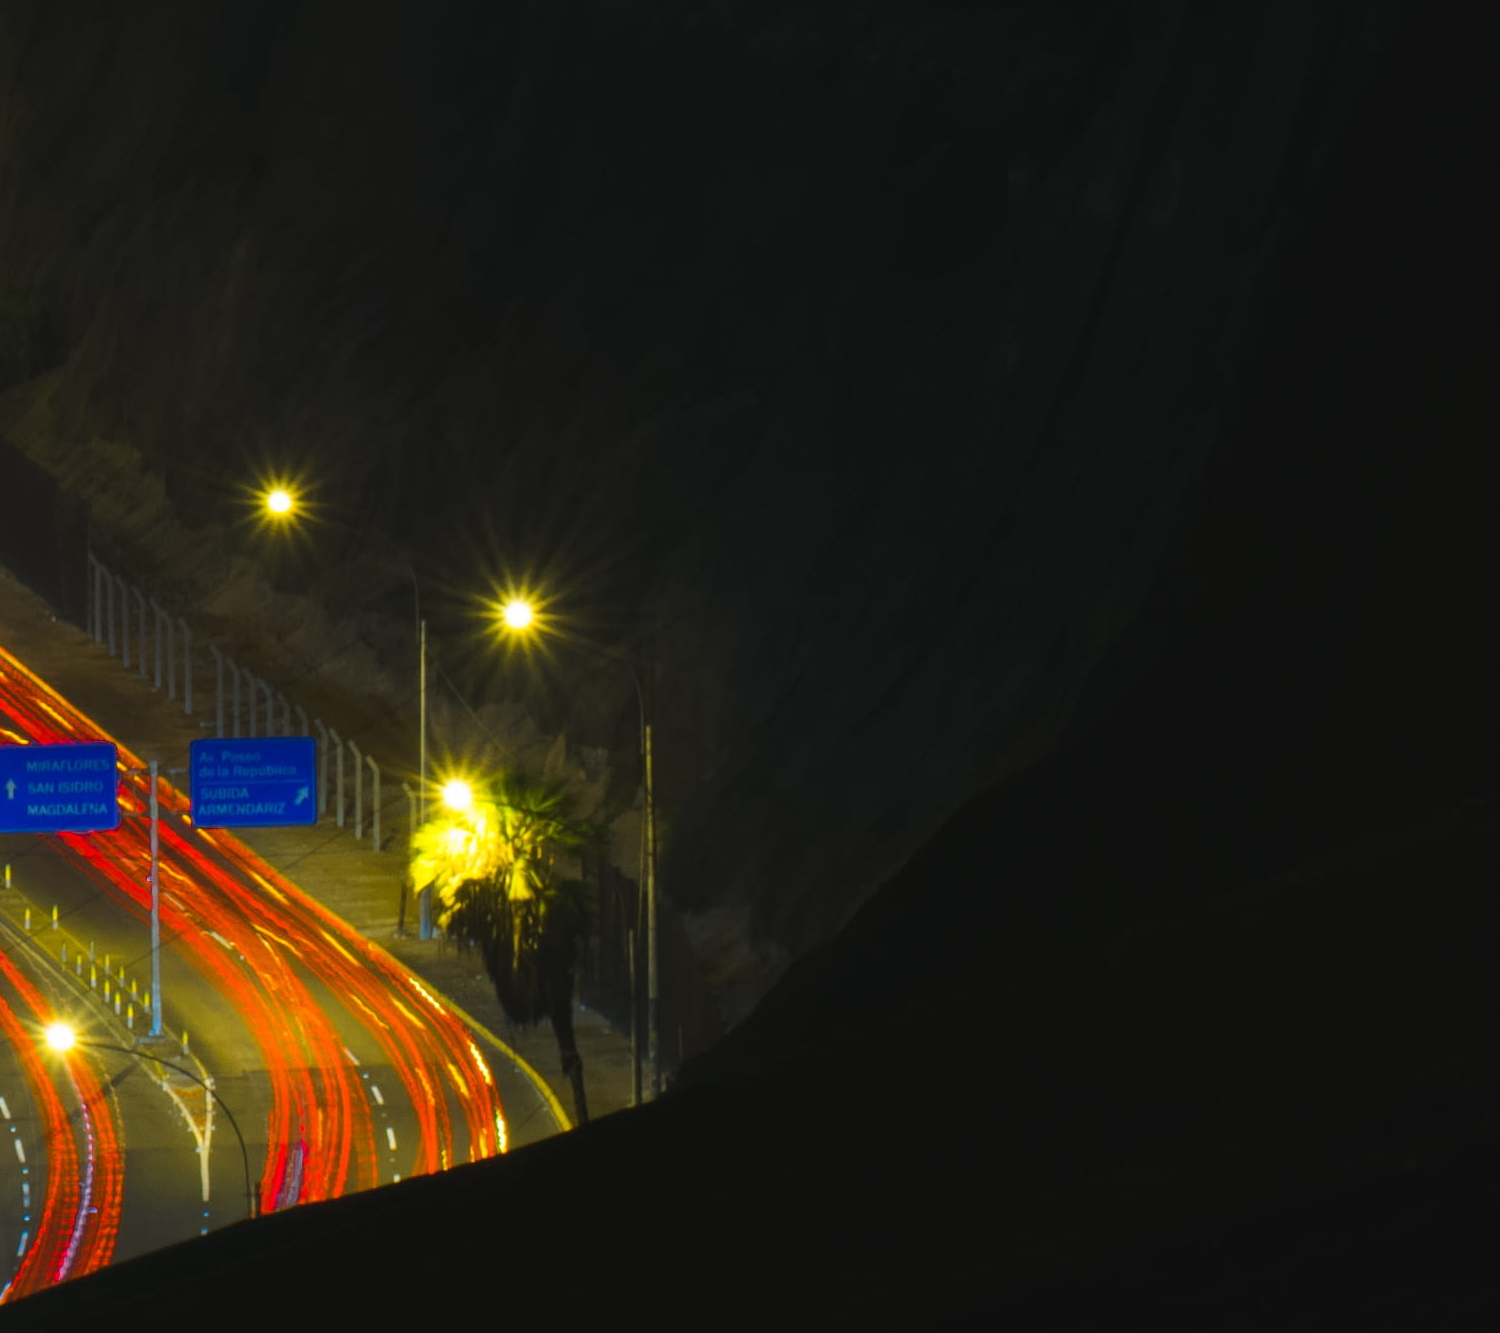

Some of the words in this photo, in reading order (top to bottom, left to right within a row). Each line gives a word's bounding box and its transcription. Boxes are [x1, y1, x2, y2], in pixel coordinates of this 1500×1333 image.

[221, 750, 262, 763] Paseo
[26, 759, 110, 773] MIRAFLORES
[199, 766, 214, 778] de
[217, 765, 230, 778] la
[27, 781, 55, 795] SAN
[57, 780, 104, 794] ISIDRO
[200, 786, 250, 800] SUBIDA
[27, 802, 108, 816] MAGDALENA
